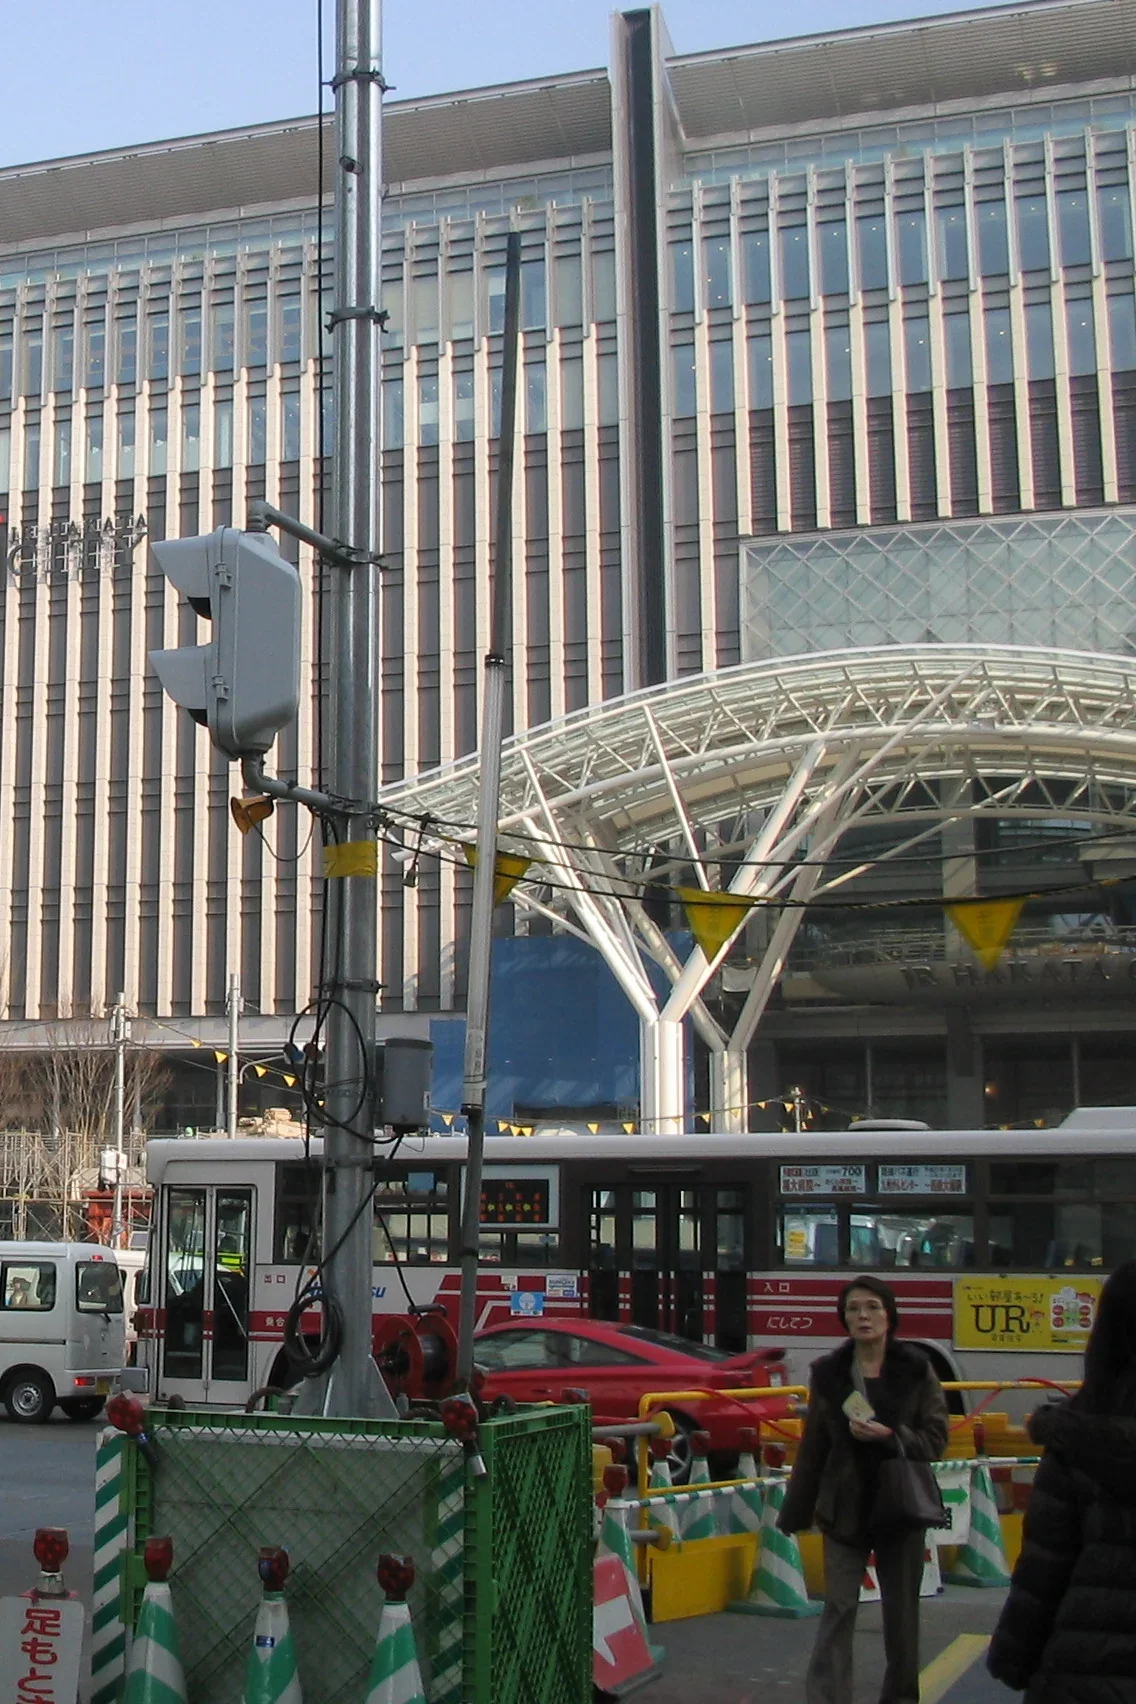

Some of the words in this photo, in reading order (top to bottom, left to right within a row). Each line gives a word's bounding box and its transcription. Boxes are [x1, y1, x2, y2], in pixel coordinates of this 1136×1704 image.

[7, 531, 149, 577] CITY
[843, 1166, 862, 1177] 700
[264, 1274, 286, 1284] 出口
[764, 1282, 790, 1293] 入口
[766, 1315, 813, 1329] にしてつ
[970, 1304, 1031, 1333] UR
